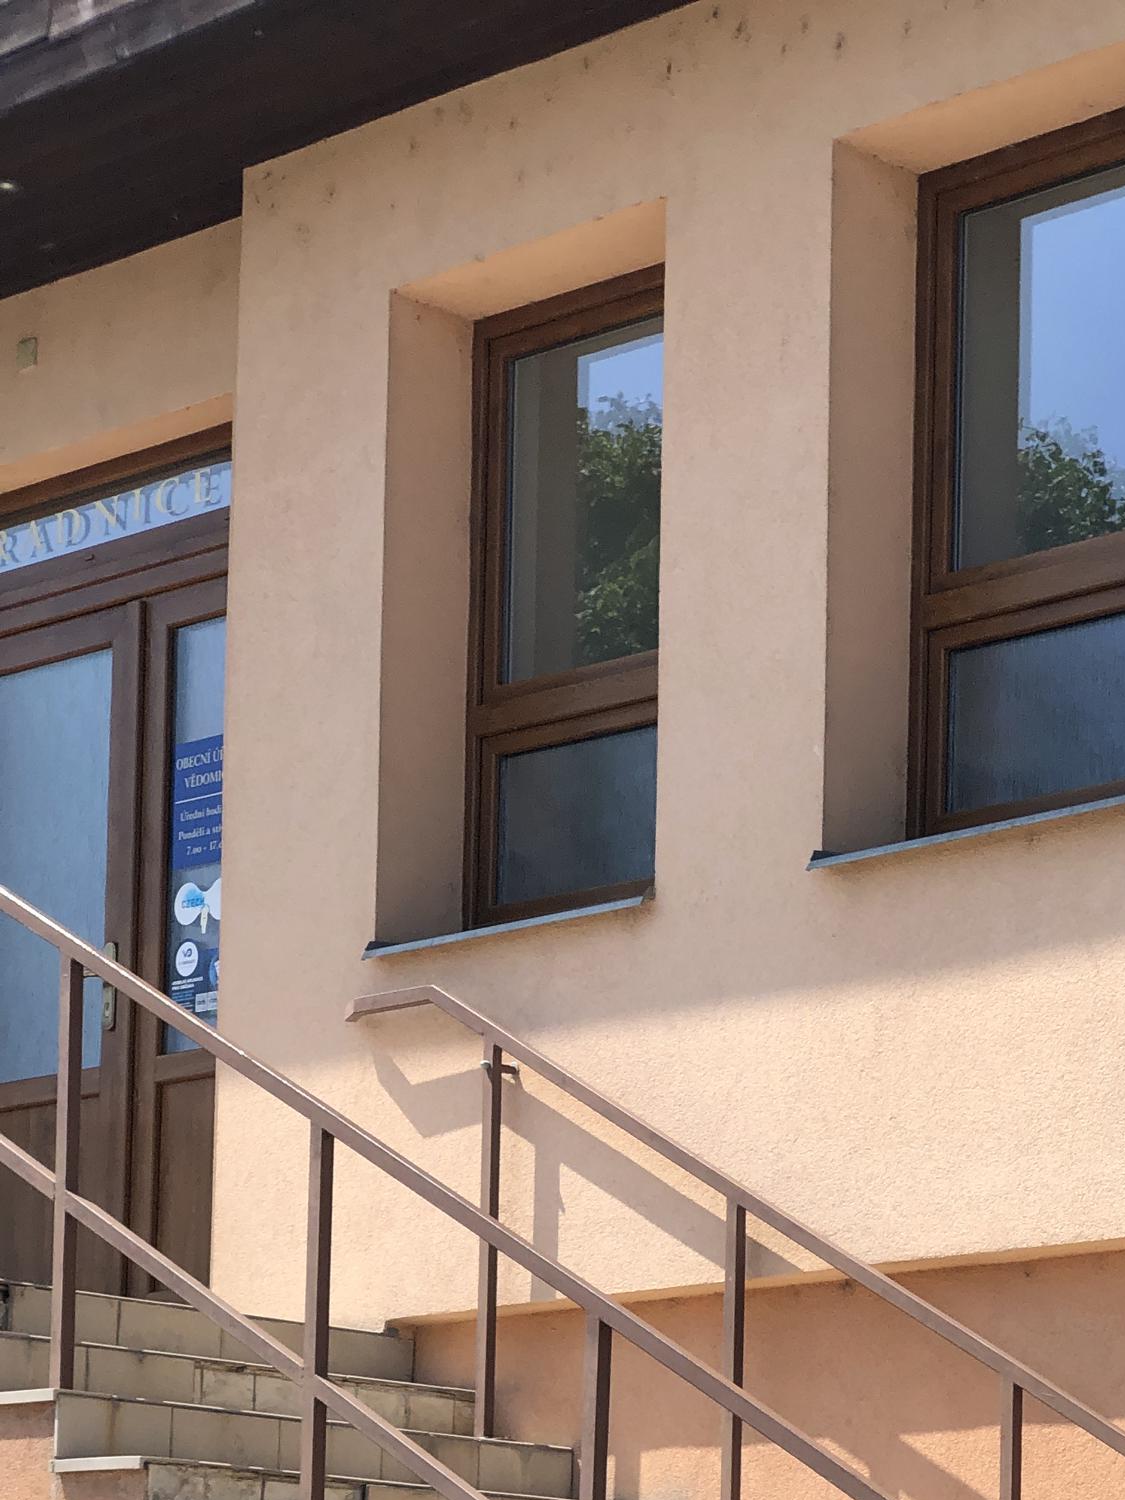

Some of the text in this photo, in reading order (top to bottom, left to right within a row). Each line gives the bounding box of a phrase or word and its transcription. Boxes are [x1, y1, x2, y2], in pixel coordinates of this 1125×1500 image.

[0, 468, 217, 561] RADNICE
[176, 748, 211, 771] OBECNÍ
[184, 770, 224, 788] VĚDOMI
